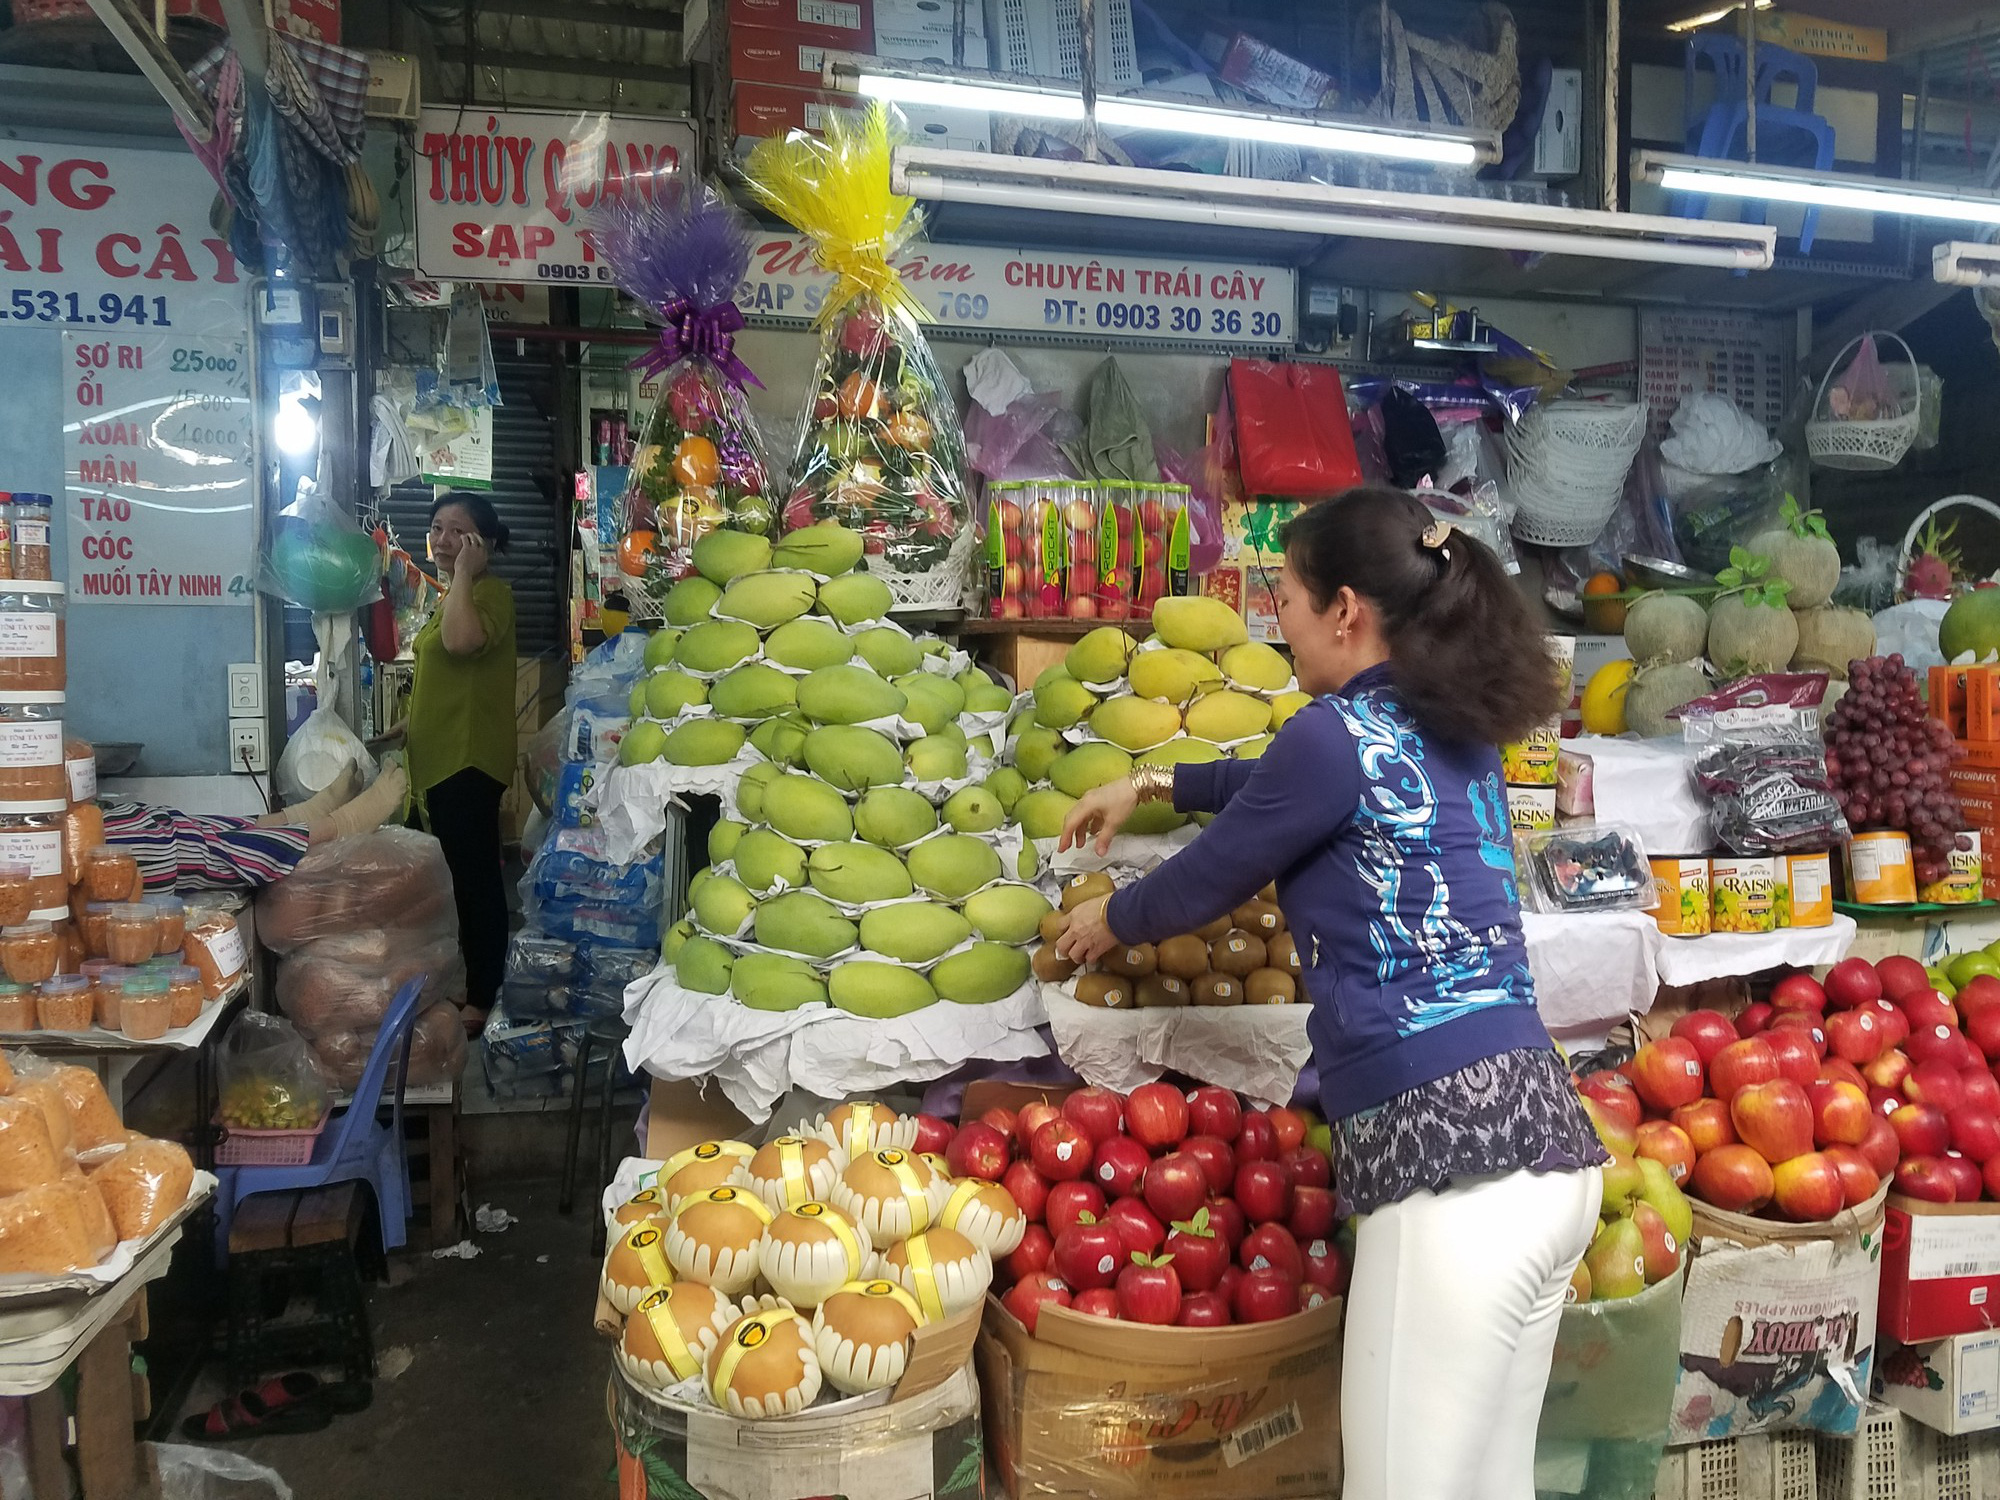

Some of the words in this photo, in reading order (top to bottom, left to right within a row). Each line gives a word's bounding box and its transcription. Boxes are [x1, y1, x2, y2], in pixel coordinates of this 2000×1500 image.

[423, 115, 536, 206] THỦY
[96, 223, 240, 284] CÂY
[452, 222, 555, 266] SẠP
[538, 264, 590, 280] 0903
[1005, 260, 1124, 292] CHUYÊN
[1135, 266, 1202, 298] TRÁI
[1211, 270, 1265, 300] CÂY
[742, 281, 794, 313] SẠP
[1044, 299, 1087, 326] ĐT:
[1096, 302, 1160, 330] 0903
[1170, 306, 1201, 332] 30
[1211, 309, 1241, 334] 36
[1251, 312, 1281, 336] 30
[76, 342, 110, 369] SƠ
[118, 346, 143, 369] RI
[169, 348, 237, 372] 25000
[77, 370, 103, 405] ỔI
[80, 454, 137, 488] MẬN
[82, 530, 133, 560] CÓC
[1047, 517, 1056, 571] ROCKIT
[1104, 517, 1112, 571] ROCKIT
[83, 565, 131, 596] MUỐI
[137, 568, 172, 596] TÂY
[179, 574, 221, 596] NINH
[1266, 625, 1277, 635] 26
[1510, 808, 1551, 823] AISINS
[1800, 794, 1825, 812] FARM
[1733, 1299, 1787, 1316] APPLES
